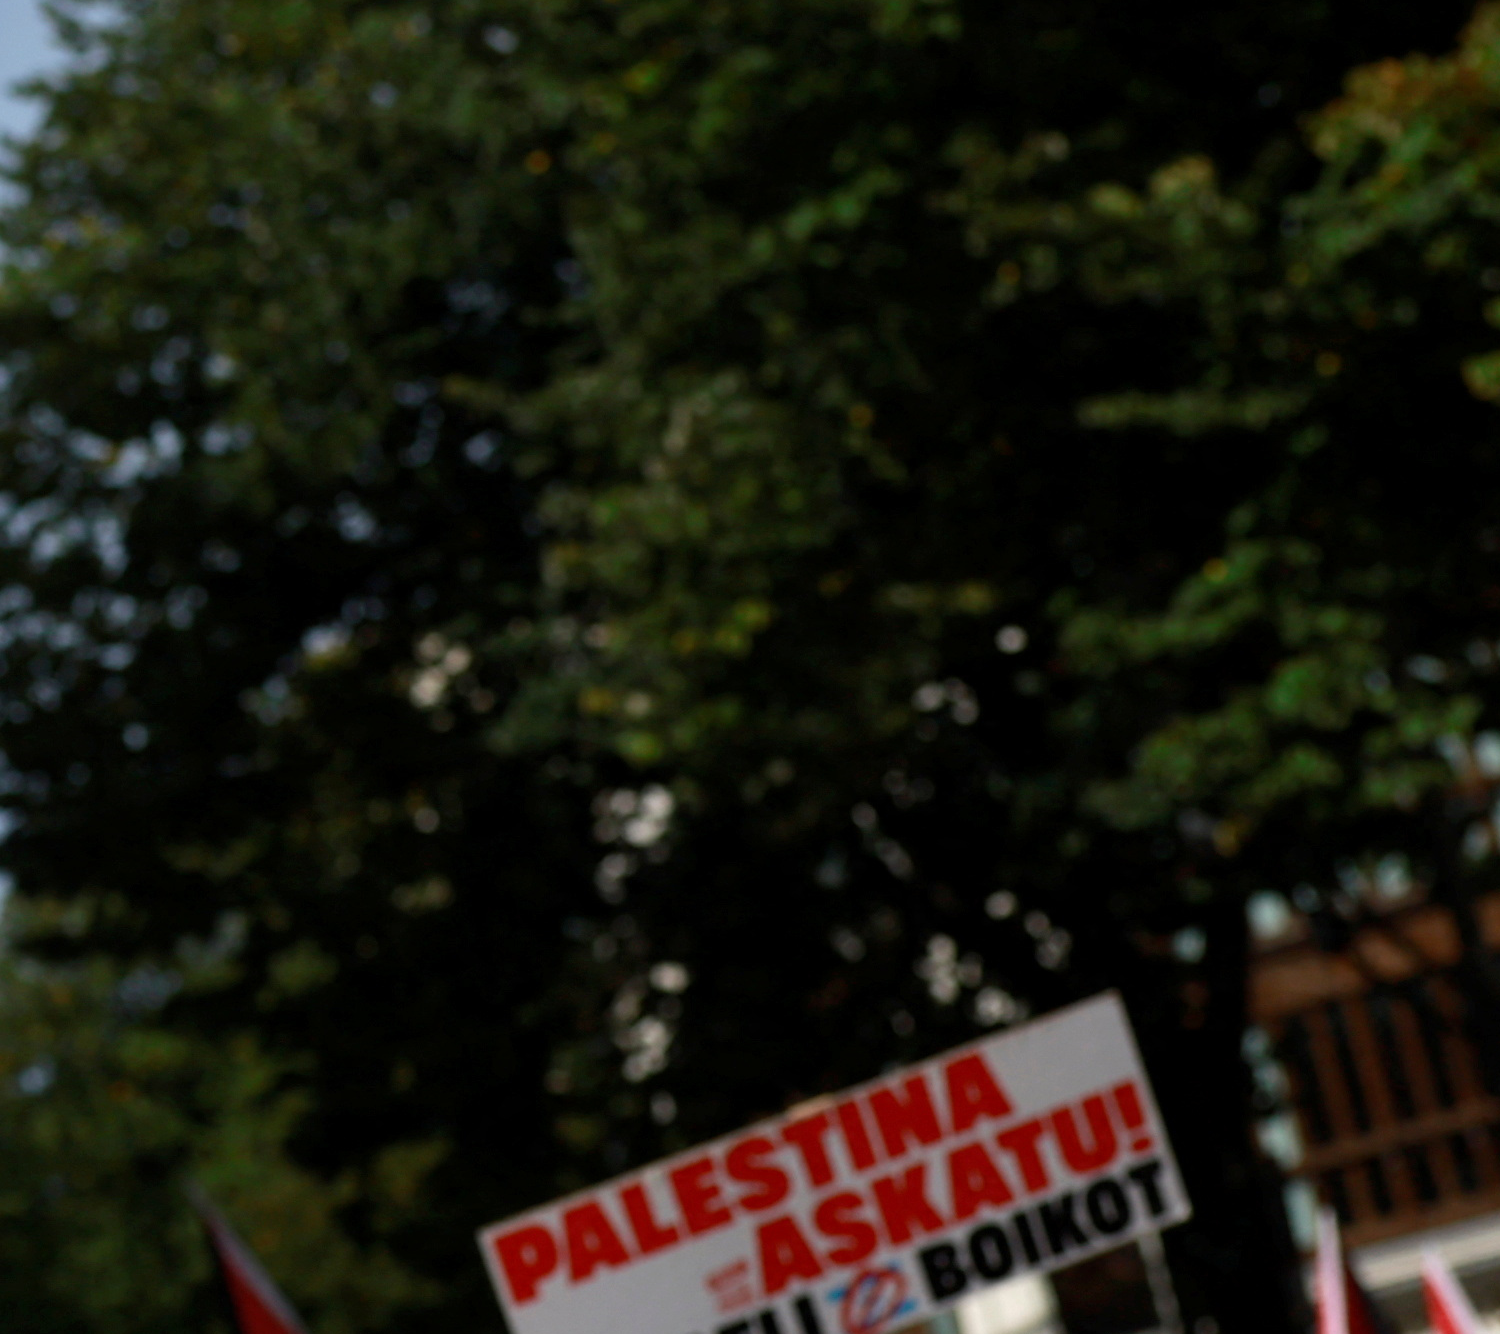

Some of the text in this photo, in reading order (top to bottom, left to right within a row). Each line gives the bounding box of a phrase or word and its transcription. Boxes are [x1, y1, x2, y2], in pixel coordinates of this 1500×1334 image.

[492, 1051, 1014, 1307] PALESTINA
[753, 1079, 1157, 1298] ASKATU!
[917, 1160, 1172, 1305] BOIKOT
